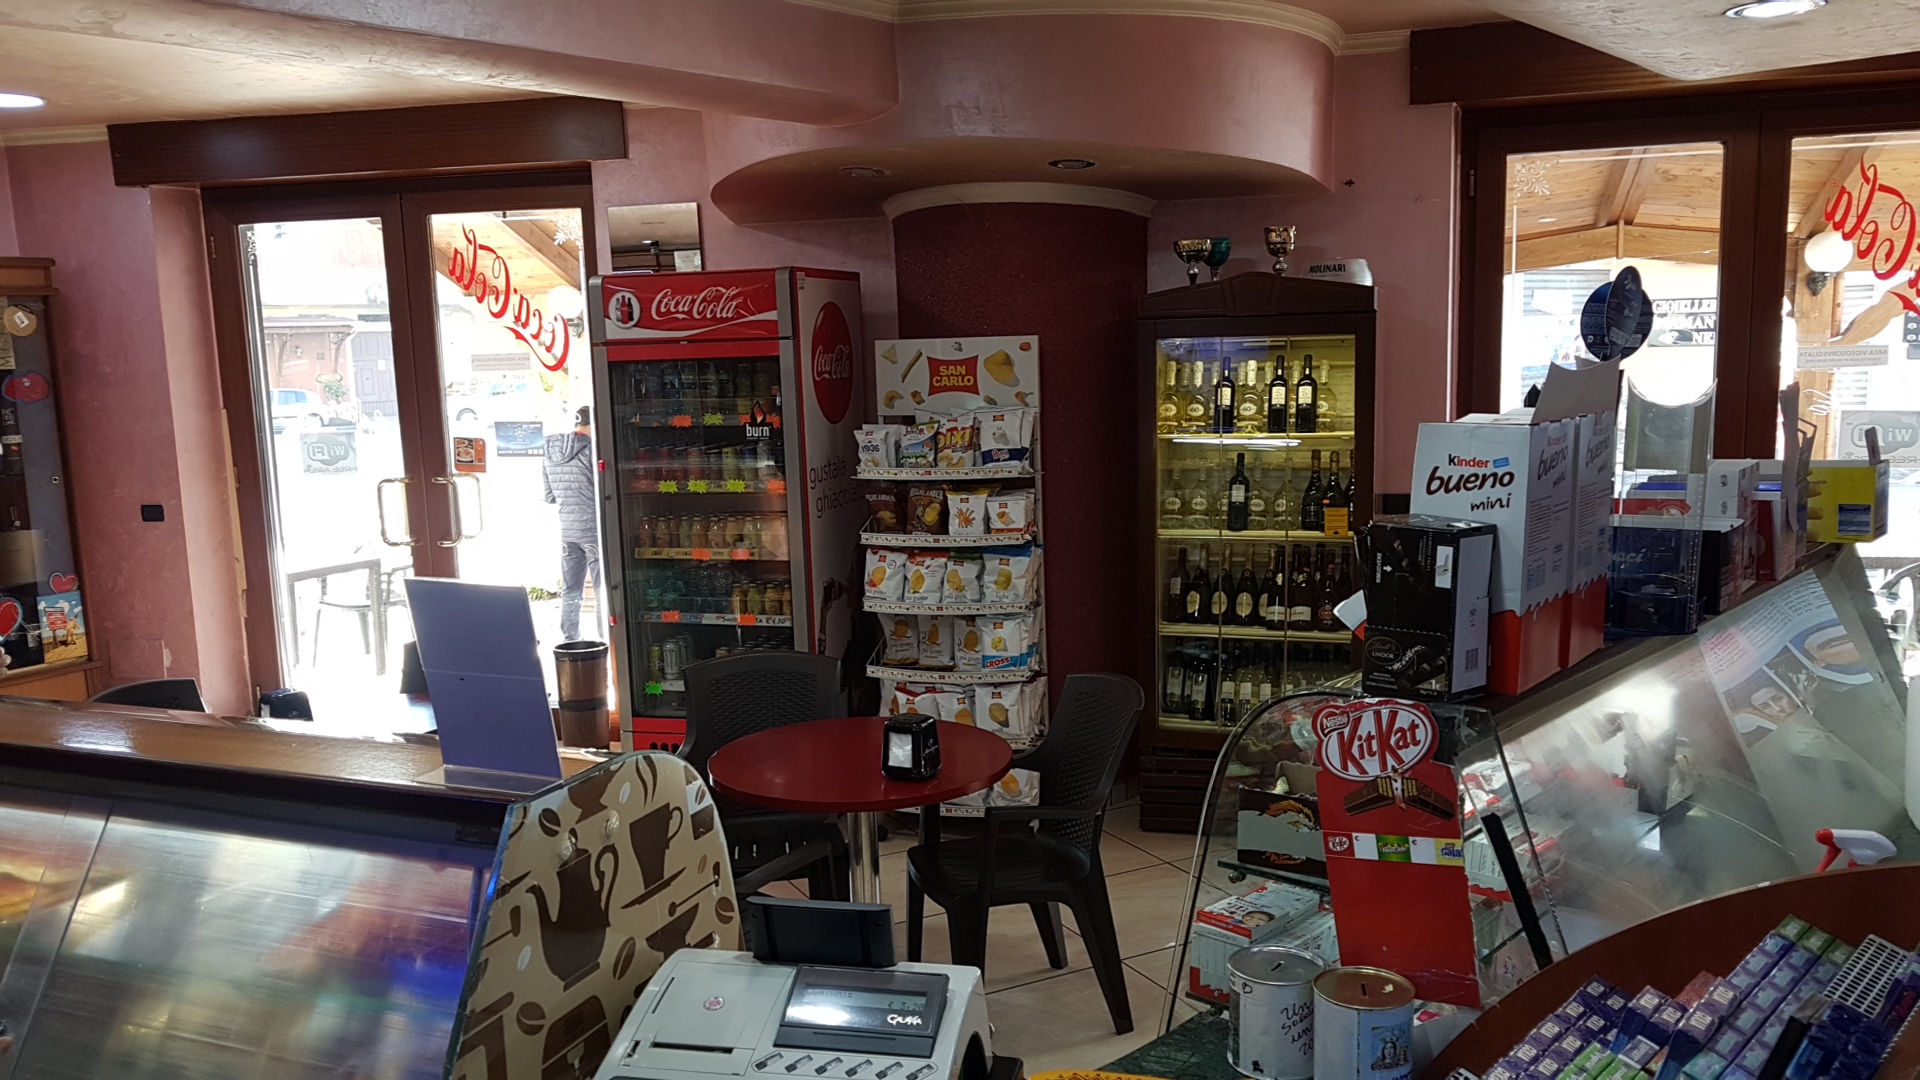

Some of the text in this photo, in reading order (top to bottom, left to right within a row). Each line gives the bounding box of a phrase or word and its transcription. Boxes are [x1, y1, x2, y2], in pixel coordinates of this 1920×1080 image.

[1309, 263, 1346, 274] MOLINARI
[939, 365, 966, 376] SAN
[932, 375, 975, 387] CARLO
[745, 423, 770, 437] burn
[861, 444, 880, 453] 1936
[1448, 453, 1491, 468] Kinder
[1537, 446, 1569, 481] bueno
[1425, 465, 1515, 496] bueno
[1470, 492, 1512, 511] mini
[1371, 651, 1394, 659] LINDOR
[985, 657, 1010, 669] CROSS
[1336, 710, 1421, 775] KitKat
